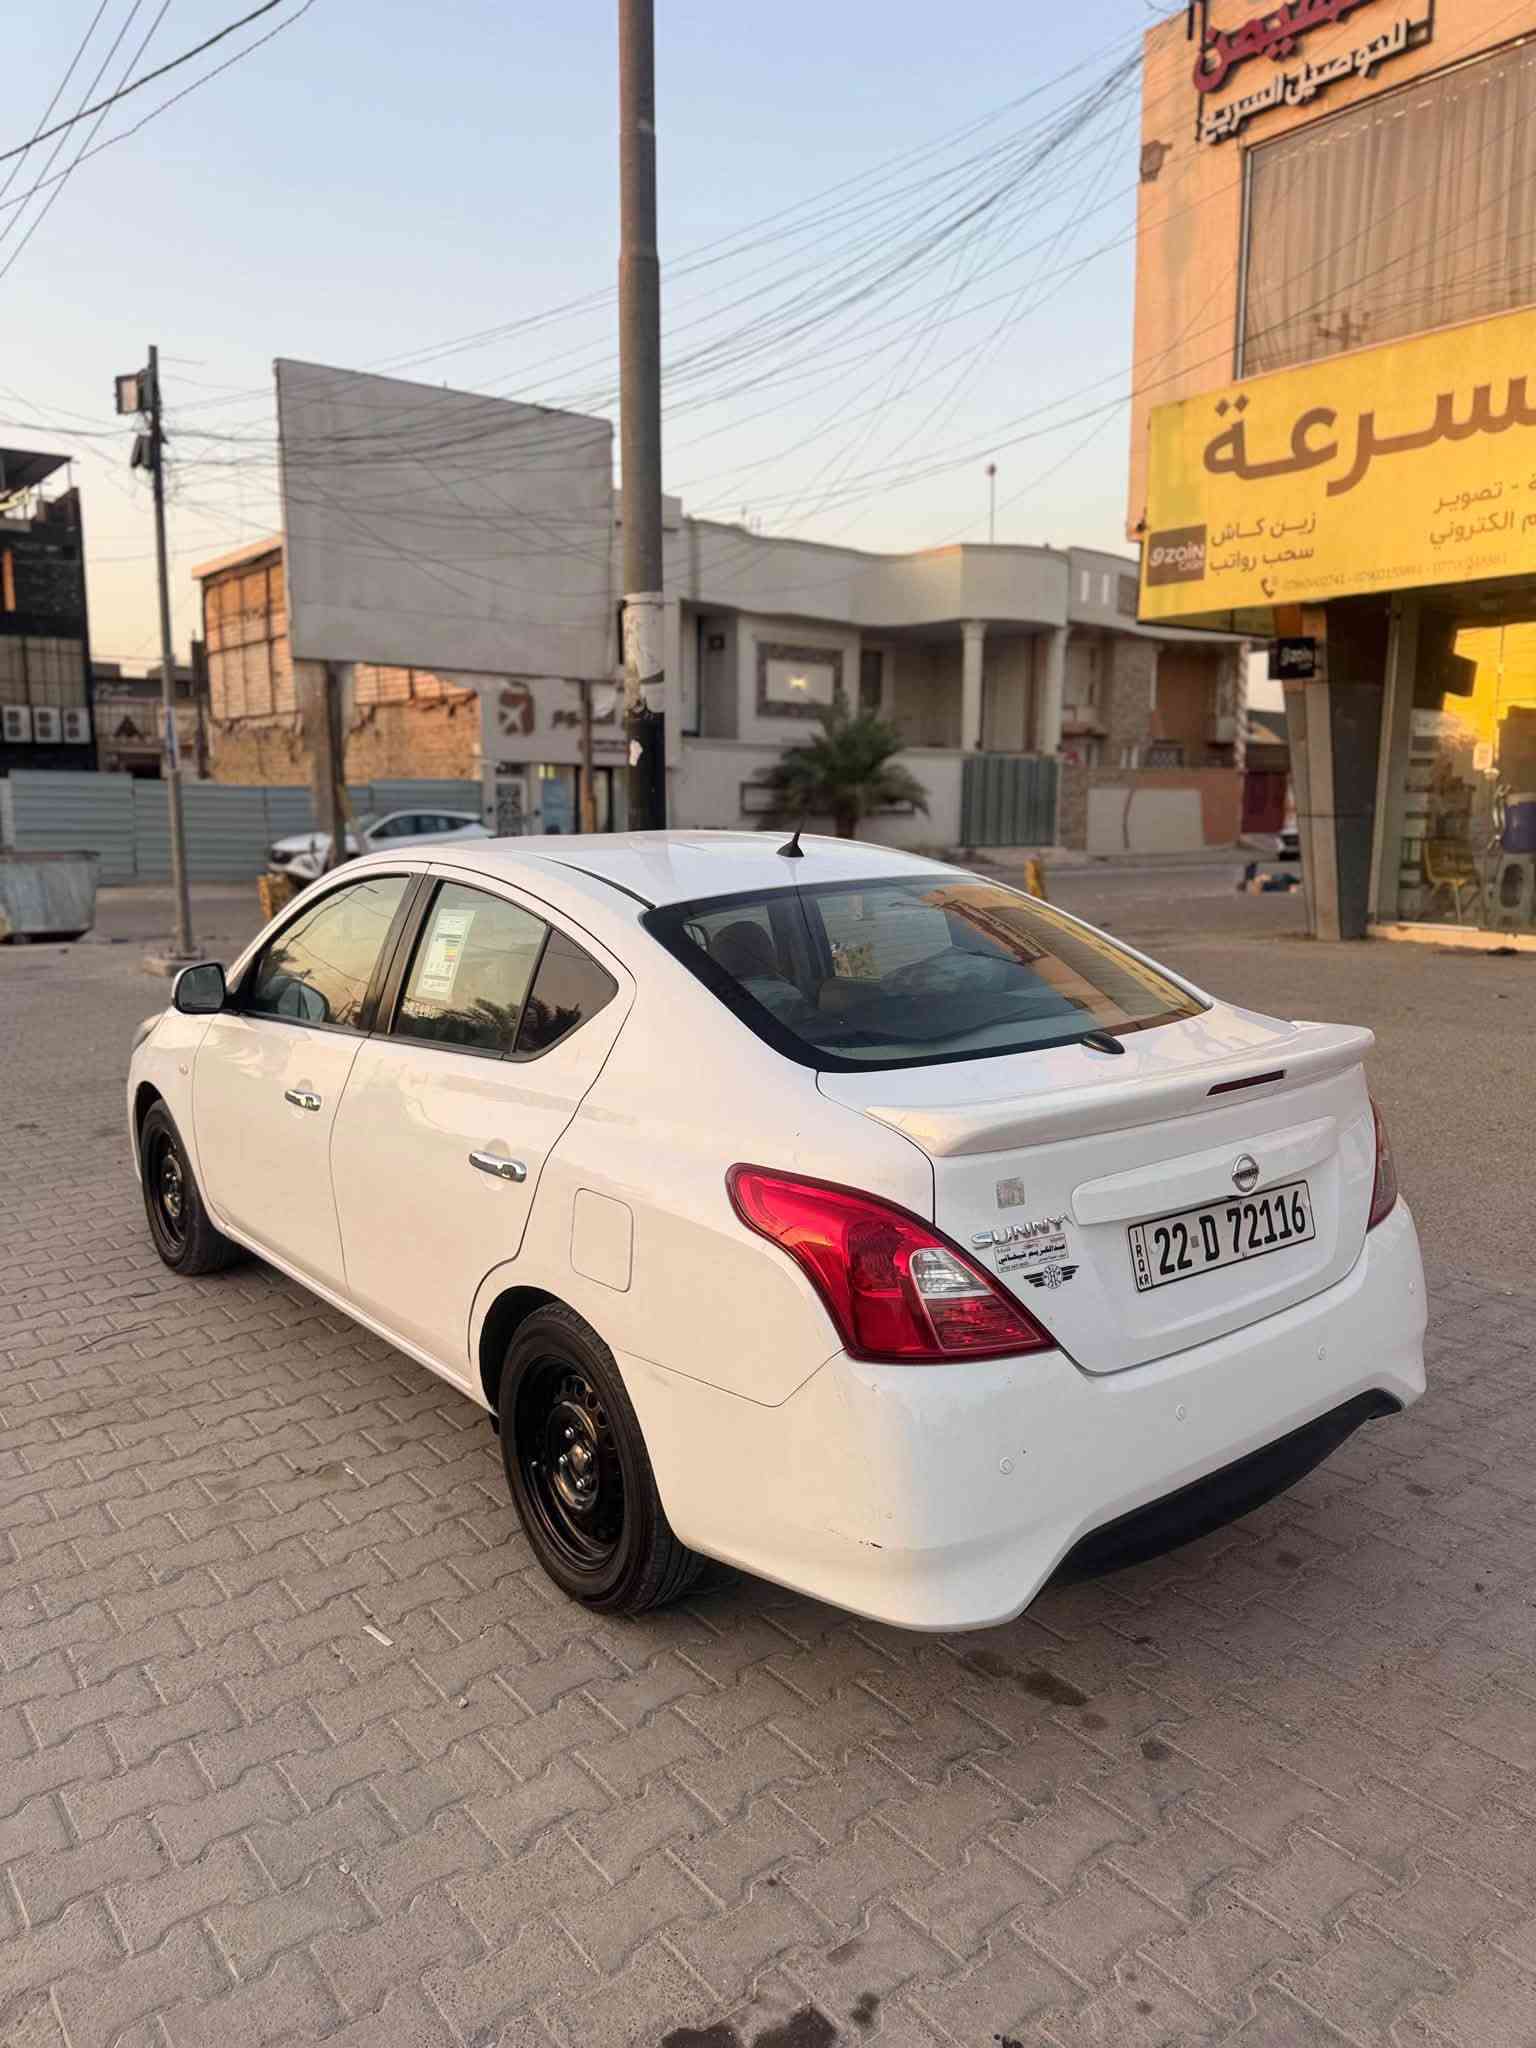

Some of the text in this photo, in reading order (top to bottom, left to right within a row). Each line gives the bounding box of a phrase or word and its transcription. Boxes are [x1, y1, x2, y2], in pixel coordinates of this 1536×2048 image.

[1432, 480, 1503, 514] تصوير
[1210, 512, 1317, 547] زين كاش
[1429, 504, 1515, 550] الكتروني
[1209, 546, 1314, 576] سحب رواتب
[970, 1212, 1074, 1249] SUNNY
[1154, 1191, 1306, 1275] 22 D 72116
